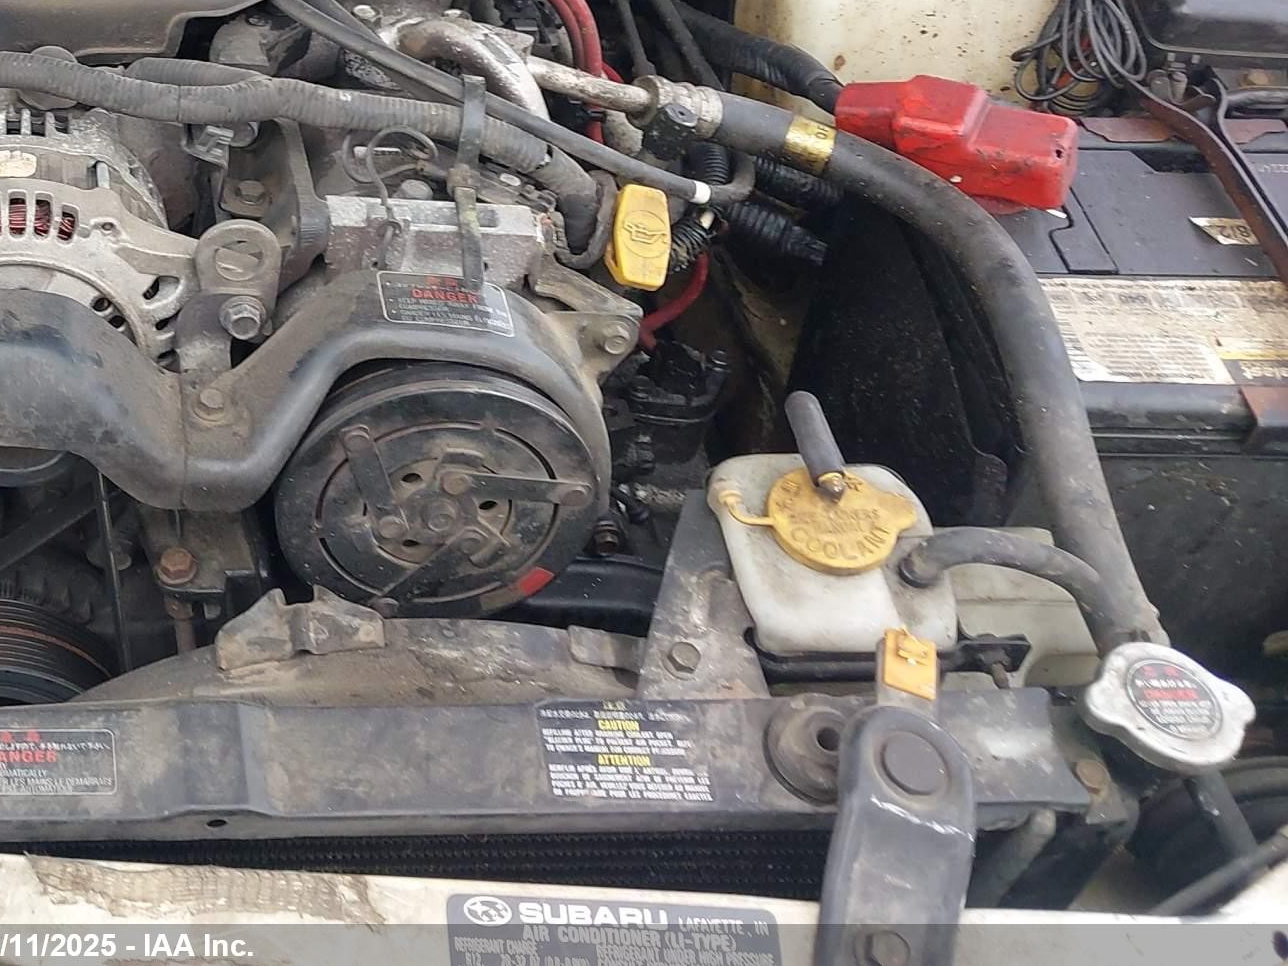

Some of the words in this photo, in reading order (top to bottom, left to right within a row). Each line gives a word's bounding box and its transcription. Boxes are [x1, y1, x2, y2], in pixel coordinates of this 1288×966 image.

[411, 289, 478, 303] DANGER
[790, 525, 891, 560] COOLANT
[598, 719, 640, 731] CAUTION
[598, 754, 651, 766] ATTENTION
[518, 902, 669, 931] SUBARU
[522, 924, 551, 942] AIR
[557, 926, 662, 948] CONDITIONER
